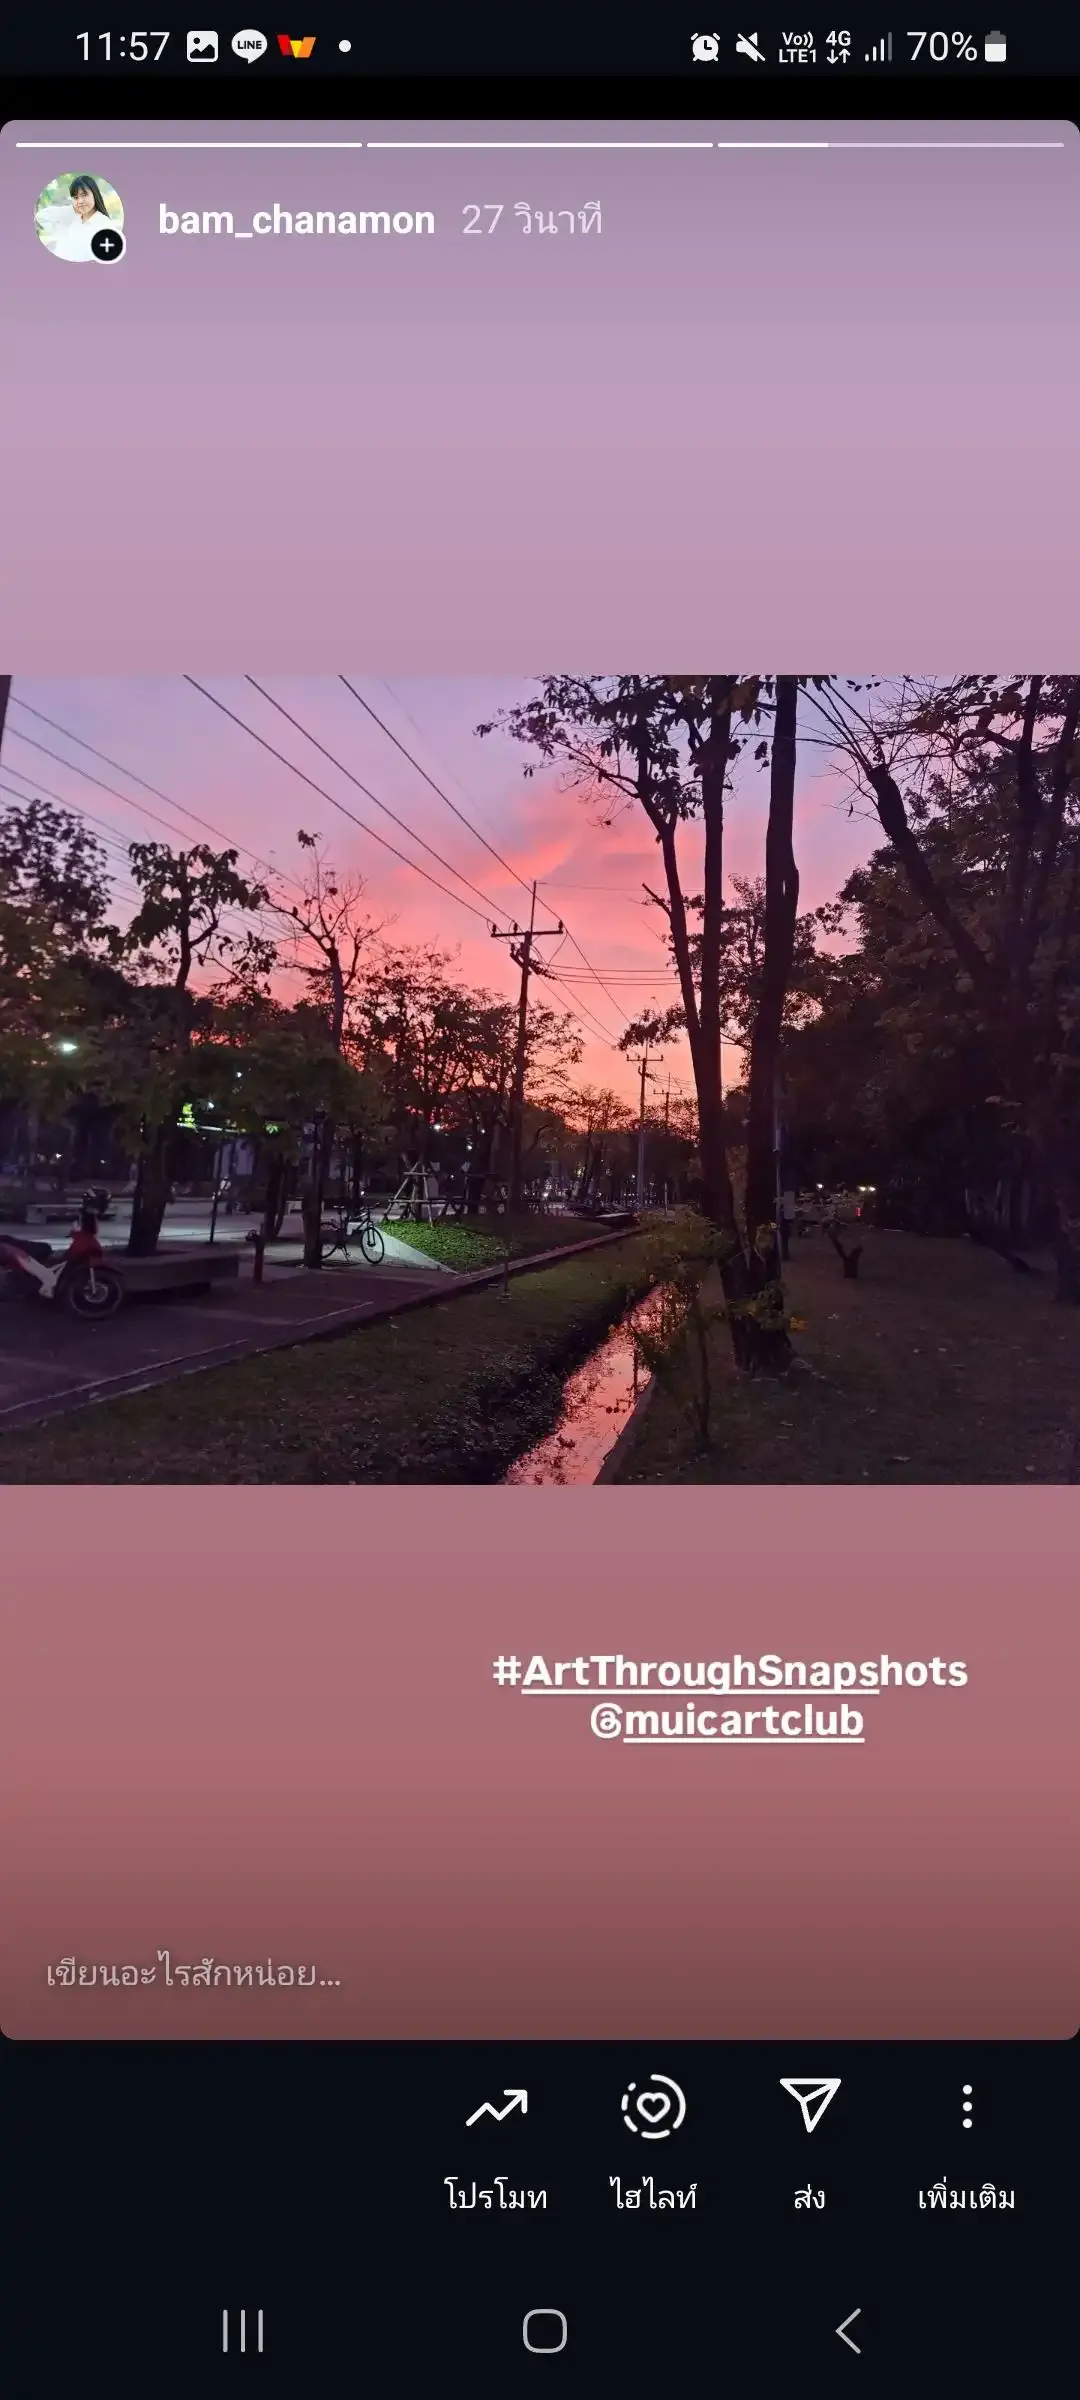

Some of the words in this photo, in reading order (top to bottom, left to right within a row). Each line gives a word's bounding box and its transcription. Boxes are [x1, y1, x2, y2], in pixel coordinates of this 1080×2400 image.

[77, 32, 169, 61] 11:57
[237, 40, 262, 50] LINE
[826, 31, 851, 46] 4G
[907, 32, 978, 61] 70%
[779, 49, 816, 63] LTE1
[159, 204, 435, 238] bam_chanamon
[462, 204, 504, 234] 27
[514, 200, 602, 234] วินาที
[47, 1950, 341, 1986] เขียนอะไรสักหน่อย...
[442, 2176, 547, 2209] โปรโมท
[609, 2176, 699, 2209] ไฮไลท์
[794, 2183, 825, 2209] ส่ง
[918, 2175, 1015, 2209] เพิ่มเติม
